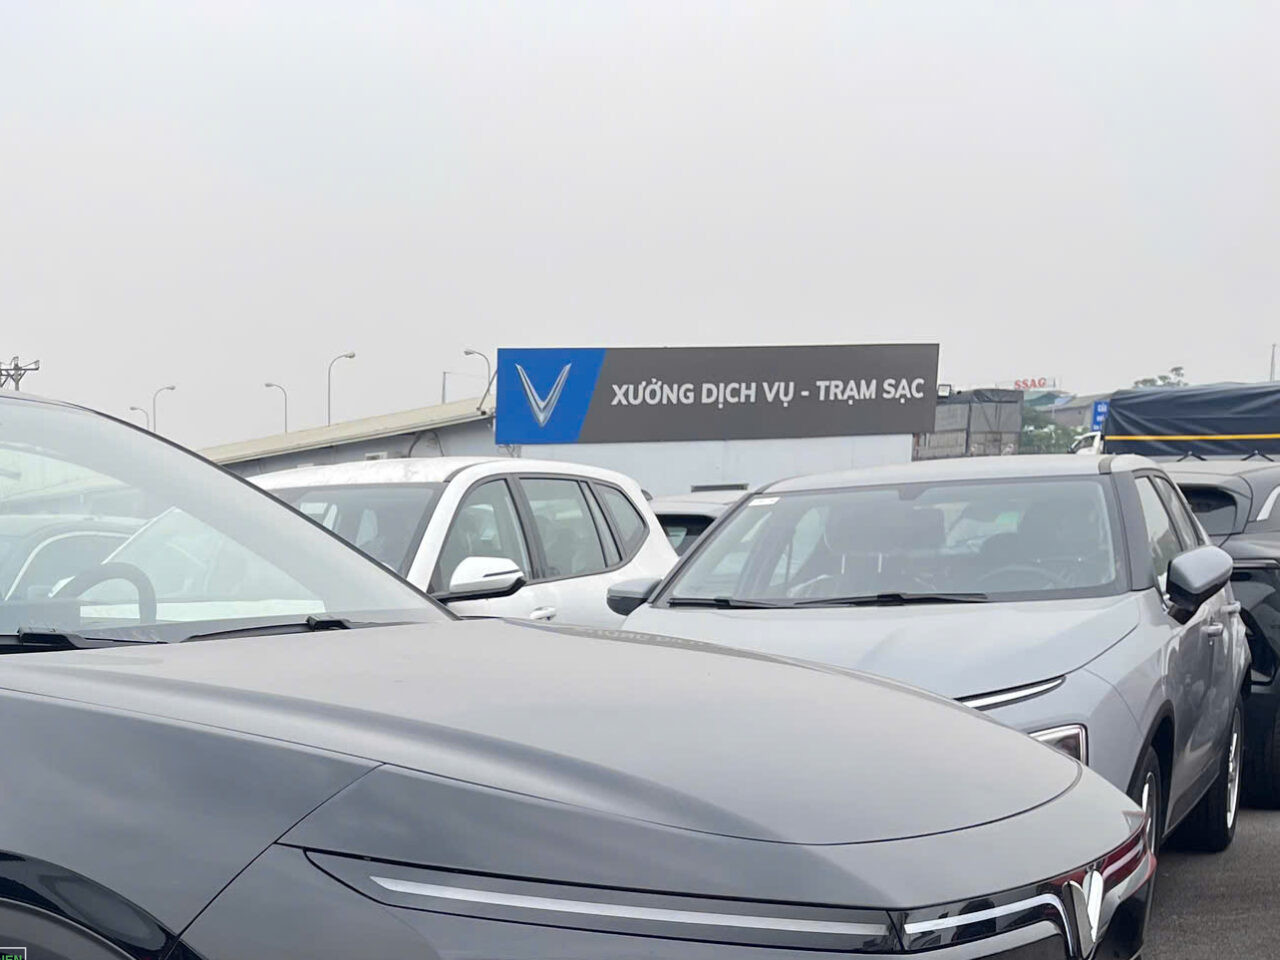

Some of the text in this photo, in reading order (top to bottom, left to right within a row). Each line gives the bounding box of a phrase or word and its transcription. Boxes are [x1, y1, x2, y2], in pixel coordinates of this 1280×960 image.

[611, 378, 695, 405] XƯỞNG
[701, 382, 756, 409] DỊCH
[763, 381, 795, 408] VỤ
[816, 380, 876, 405] TRẠM
[882, 378, 925, 404] SẠC
